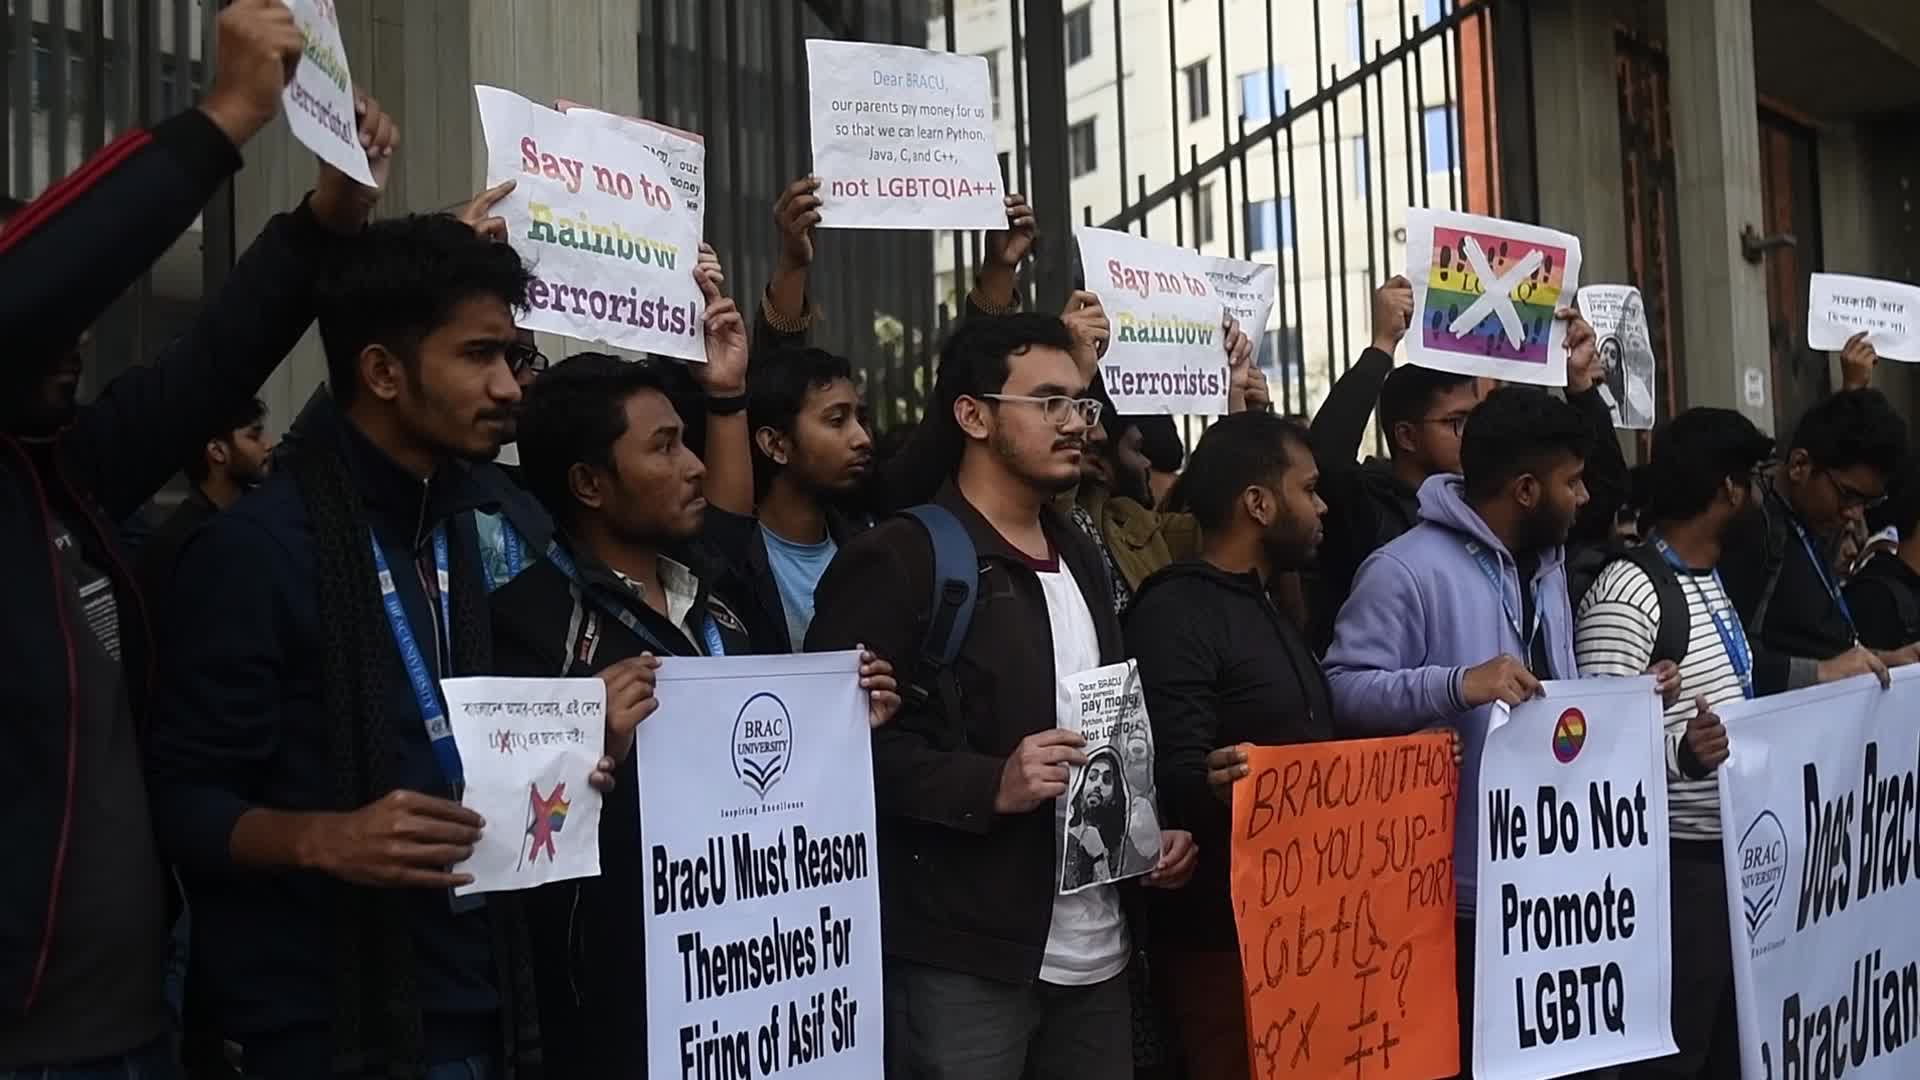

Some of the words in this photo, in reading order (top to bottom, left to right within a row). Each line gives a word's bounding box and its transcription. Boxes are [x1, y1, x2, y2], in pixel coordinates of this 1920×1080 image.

[873, 70, 904, 87] Dear
[906, 73, 949, 92] BRACU,
[832, 100, 852, 111] our
[855, 102, 898, 114] parents
[919, 105, 954, 117] money
[957, 104, 972, 117] for
[974, 109, 985, 118] us
[835, 124, 849, 136] so
[852, 122, 875, 136] that
[878, 125, 895, 137] we
[899, 126, 914, 138] can
[917, 126, 943, 139] learn
[946, 127, 986, 143] Python,
[679, 161, 699, 175] our
[869, 149, 897, 164] Java,
[900, 149, 911, 163] C,
[913, 150, 931, 162] and
[520, 136, 584, 194] Say
[592, 165, 634, 201] no
[639, 173, 673, 211] to
[832, 178, 869, 197] not
[877, 177, 996, 200] LGBTQIA++
[686, 199, 699, 212] we
[527, 200, 678, 271] Rainbow
[1108, 259, 1150, 299] Say
[1155, 271, 1182, 294] no
[1183, 272, 1208, 297] to
[527, 279, 697, 337] errorists!
[1117, 311, 1214, 346] Rainbow
[1105, 365, 1229, 396] Terrorists!
[402, 635, 436, 711] UNIVERSITY
[1078, 682, 1097, 692] Dear
[1098, 676, 1122, 689] BRACU
[1081, 700, 1101, 717] pay
[1104, 694, 1139, 710] money
[744, 718, 783, 739] BRAC
[1081, 728, 1101, 742] Not
[737, 739, 788, 756] UNIVERSITY
[1247, 749, 1365, 840] BRACU
[1488, 789, 1527, 861] We
[1537, 786, 1579, 855] Do
[1589, 779, 1648, 850] Not
[1262, 839, 1303, 907] DO
[1313, 820, 1365, 886] YOU
[1371, 814, 1435, 878] SUP-
[1743, 840, 1781, 870] BRAC
[1796, 762, 1854, 932] Does
[651, 836, 727, 915] BracU
[731, 828, 789, 901] Must
[793, 825, 867, 890] Reason
[1741, 865, 1783, 889] NIVERSITY
[1501, 873, 1635, 956] Promote
[677, 916, 817, 1003] Themselves
[819, 905, 851, 971] For
[1515, 962, 1625, 1049] LGBTQ
[679, 1020, 751, 1080] Firing
[758, 1004, 780, 1076] of
[787, 992, 825, 1068] Asif
[831, 986, 858, 1053] Sir
